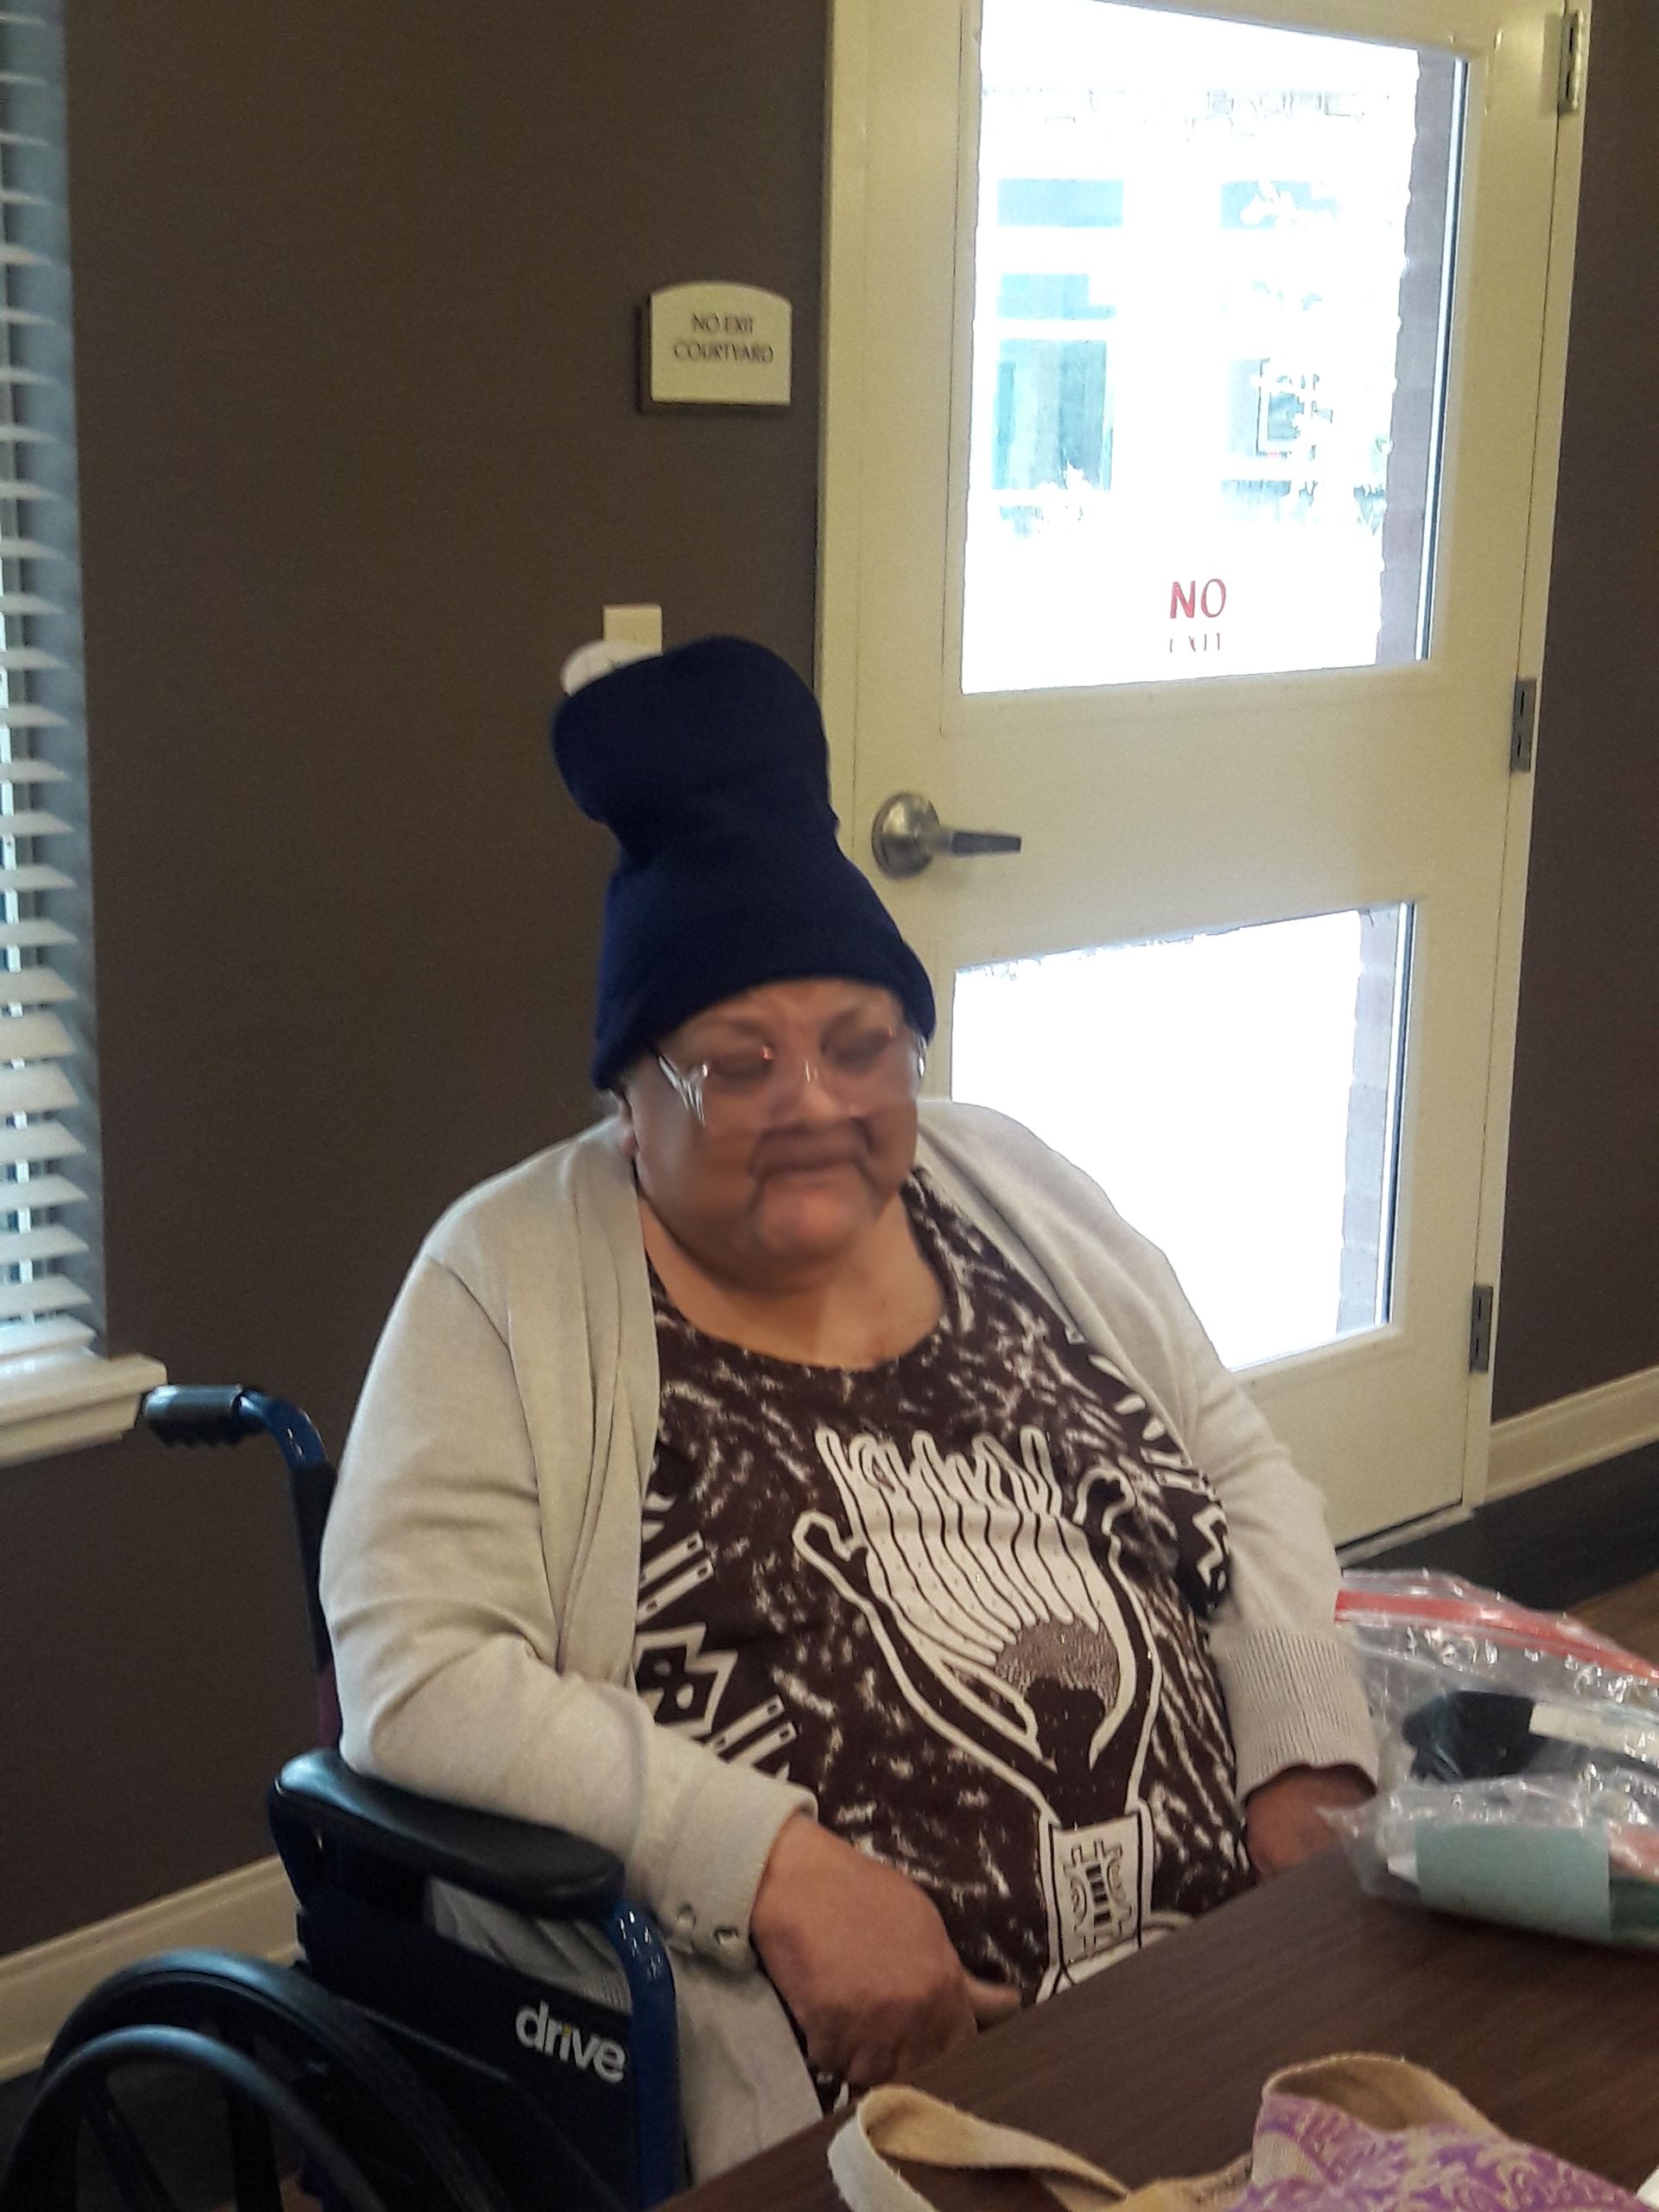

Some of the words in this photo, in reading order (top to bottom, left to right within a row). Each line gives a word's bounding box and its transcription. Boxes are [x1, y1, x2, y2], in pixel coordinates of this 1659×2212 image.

[692, 313, 721, 332] NO
[673, 342, 773, 362] COURTYARD
[1170, 578, 1226, 619] NO
[516, 2000, 626, 2083] drive
